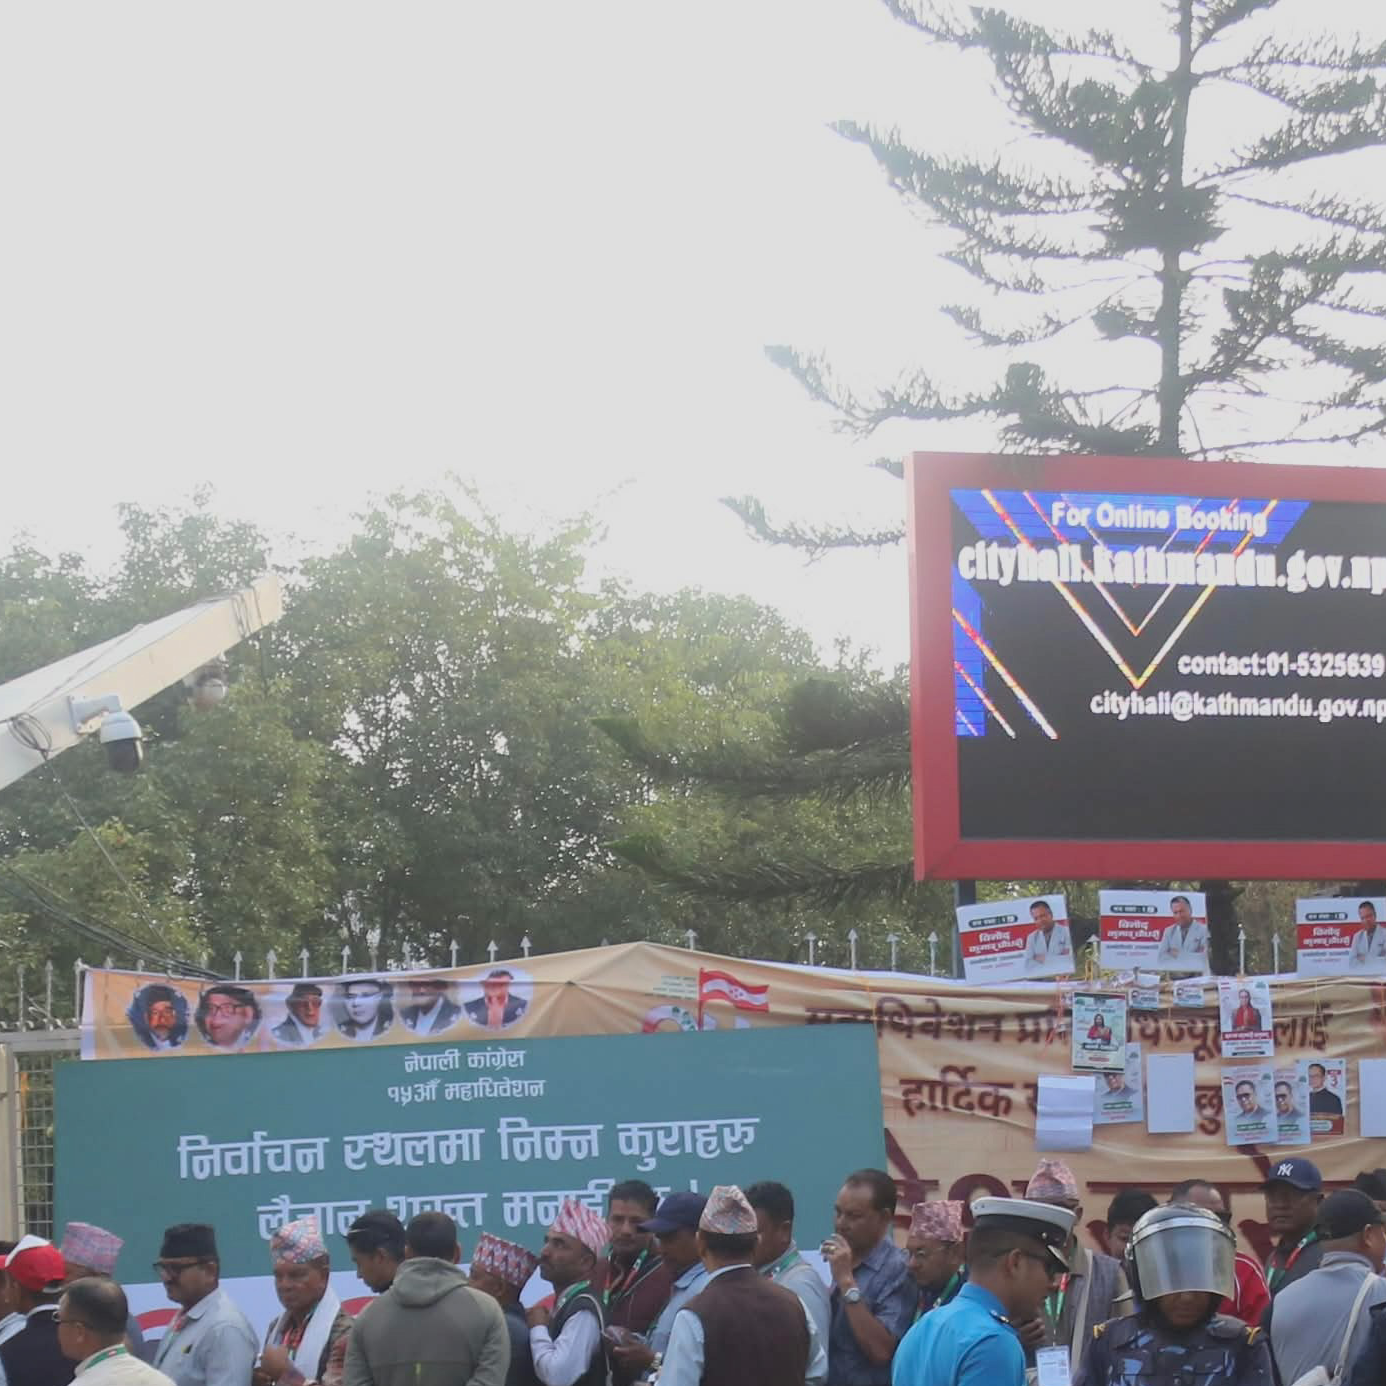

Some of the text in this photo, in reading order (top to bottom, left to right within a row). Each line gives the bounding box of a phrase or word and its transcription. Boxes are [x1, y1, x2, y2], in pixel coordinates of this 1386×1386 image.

[1051, 502, 1268, 537] For Online Booking
[1177, 652, 1386, 677] contact:01-5325639
[404, 1046, 526, 1073] नेपाली कांग्रेस
[444, 1076, 546, 1102] महाधिवेशन
[899, 1065, 1016, 1117] हार्दिक
[178, 1115, 760, 1181] निर्वाचन स्थलमा निम्न कुराहरु
